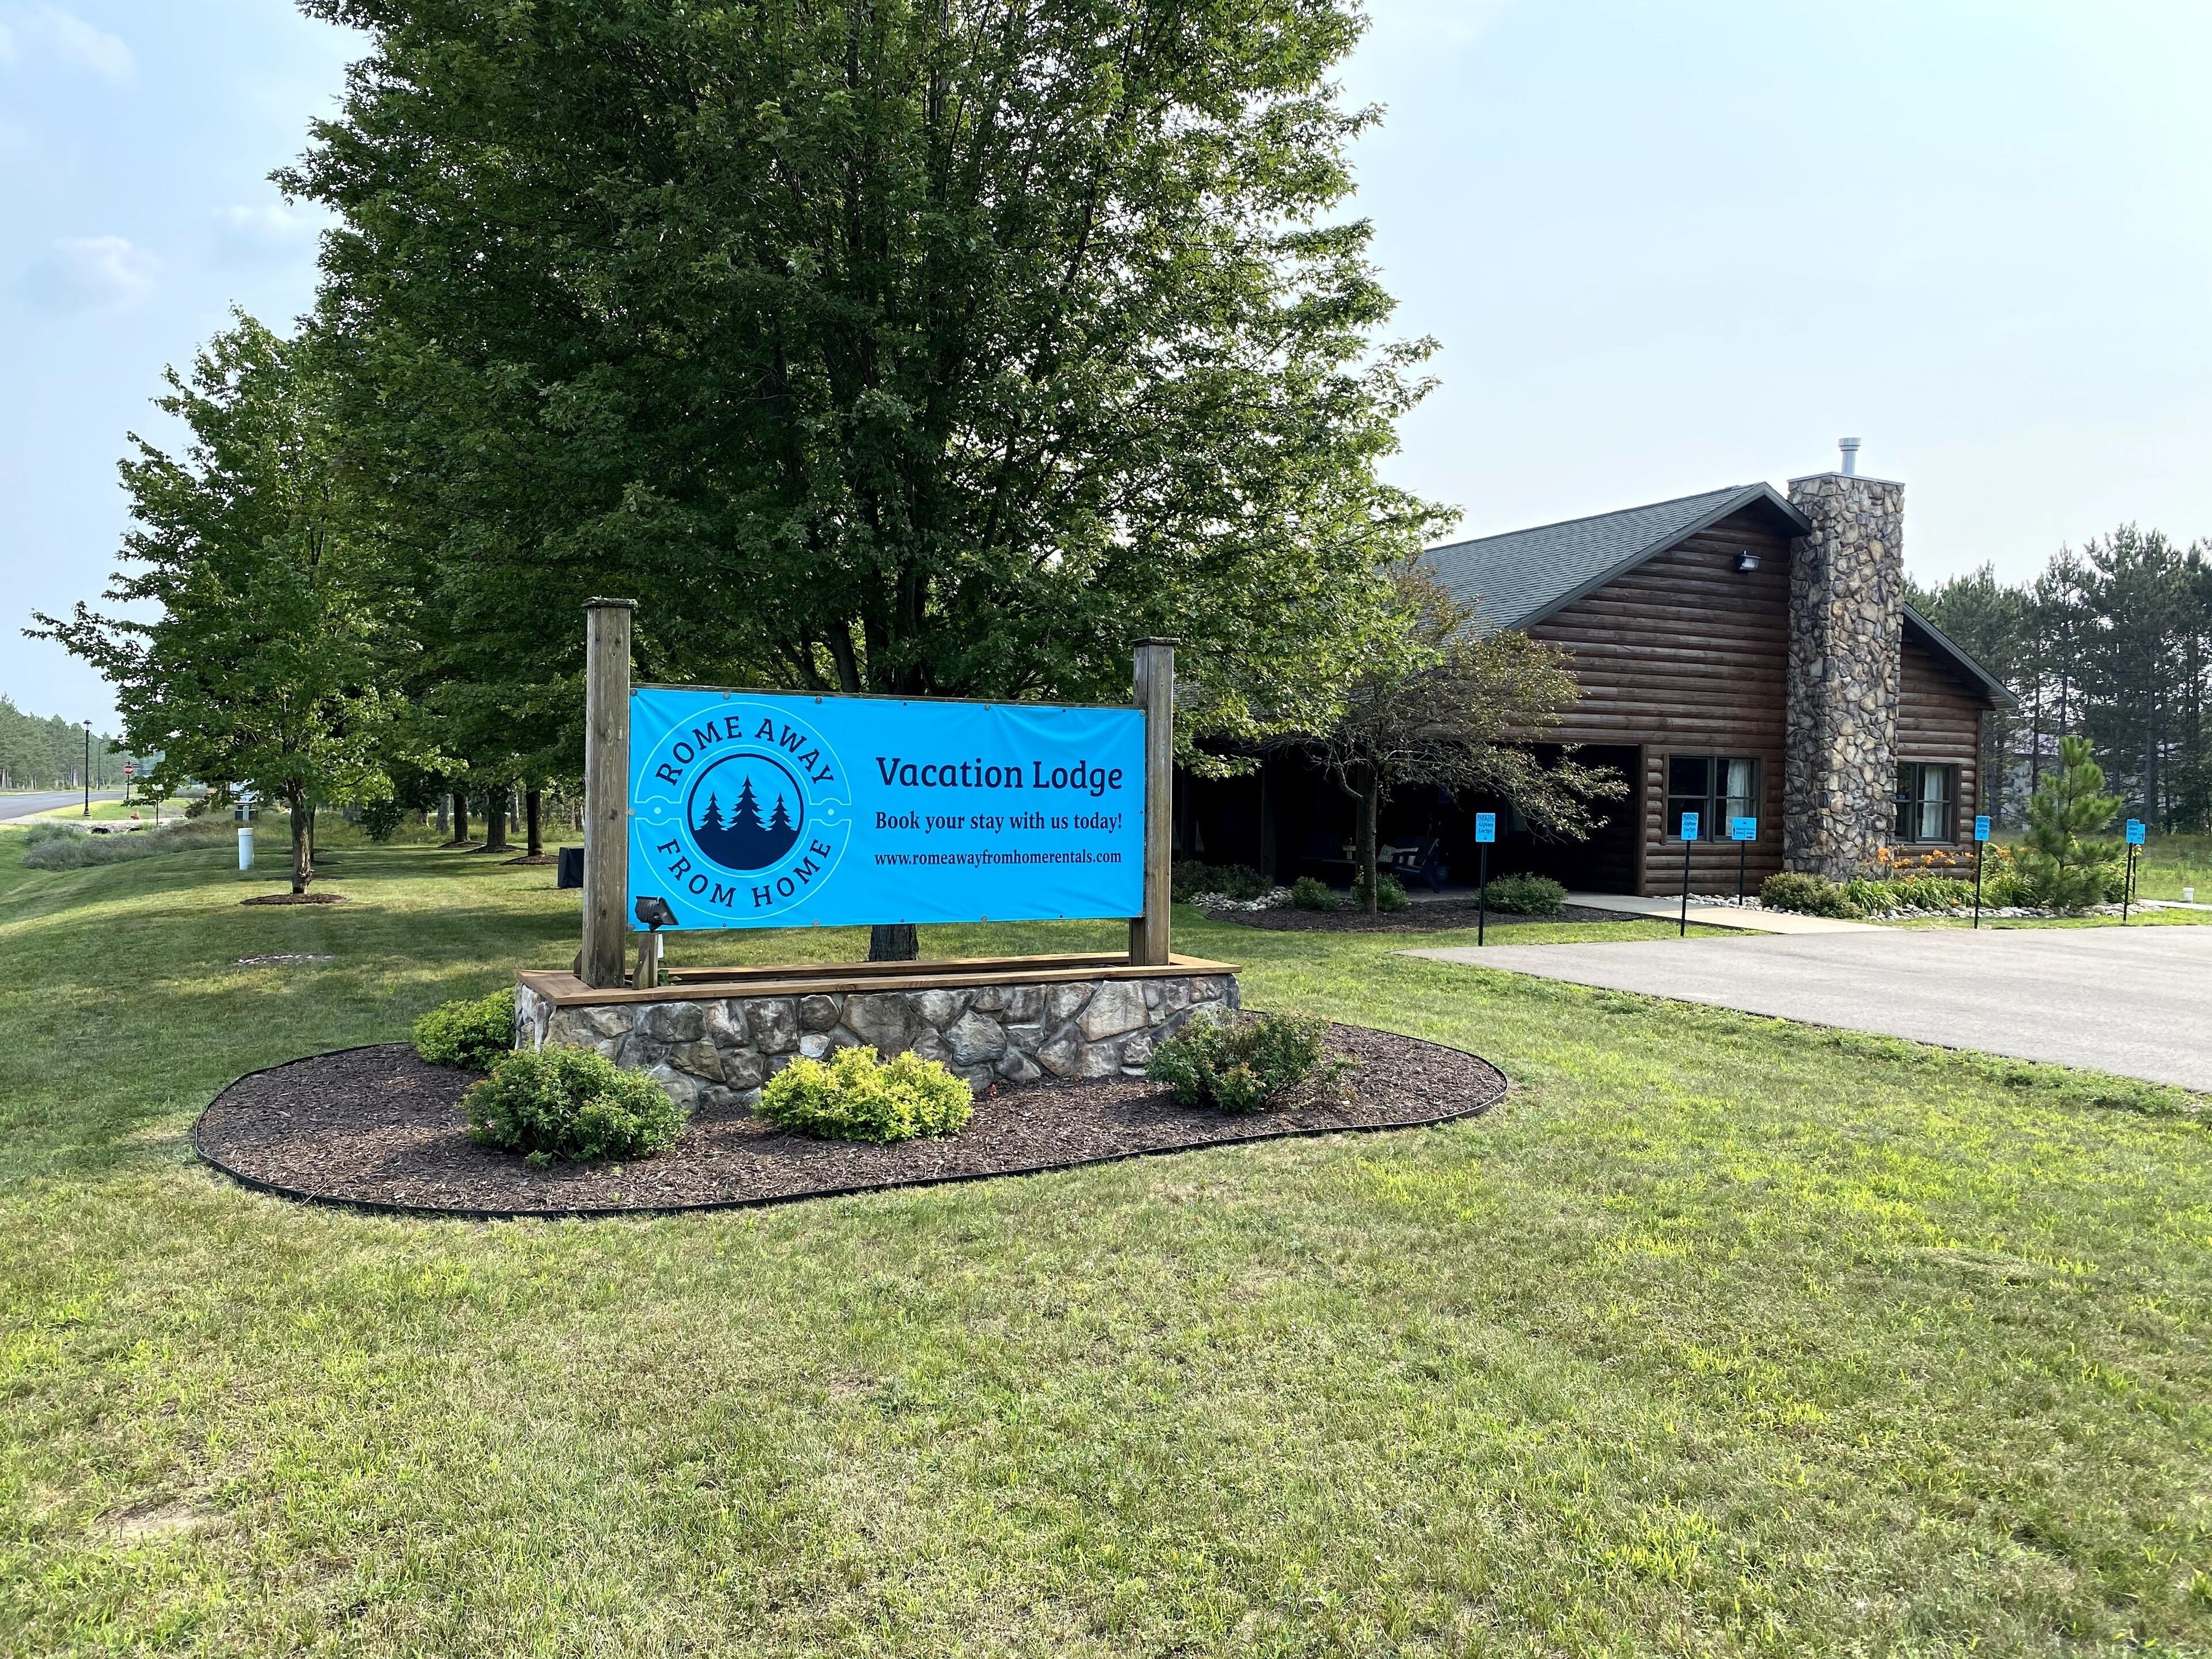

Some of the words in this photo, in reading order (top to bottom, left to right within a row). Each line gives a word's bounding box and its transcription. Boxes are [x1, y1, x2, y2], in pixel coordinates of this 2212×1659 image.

[656, 716, 742, 786] ROME
[755, 718, 834, 786] AWAY
[876, 757, 1023, 789] Vacation
[1033, 760, 1123, 797] Lodge
[876, 811, 920, 829] Book
[925, 816, 965, 834] your
[971, 813, 1004, 834] stay
[1010, 811, 1045, 829] with
[1051, 817, 1069, 829] us
[1074, 811, 1122, 834] today!
[657, 839, 736, 908] FROM
[752, 839, 831, 908] HOME
[875, 849, 1121, 868] www.romeawayfromhomerentals.com
